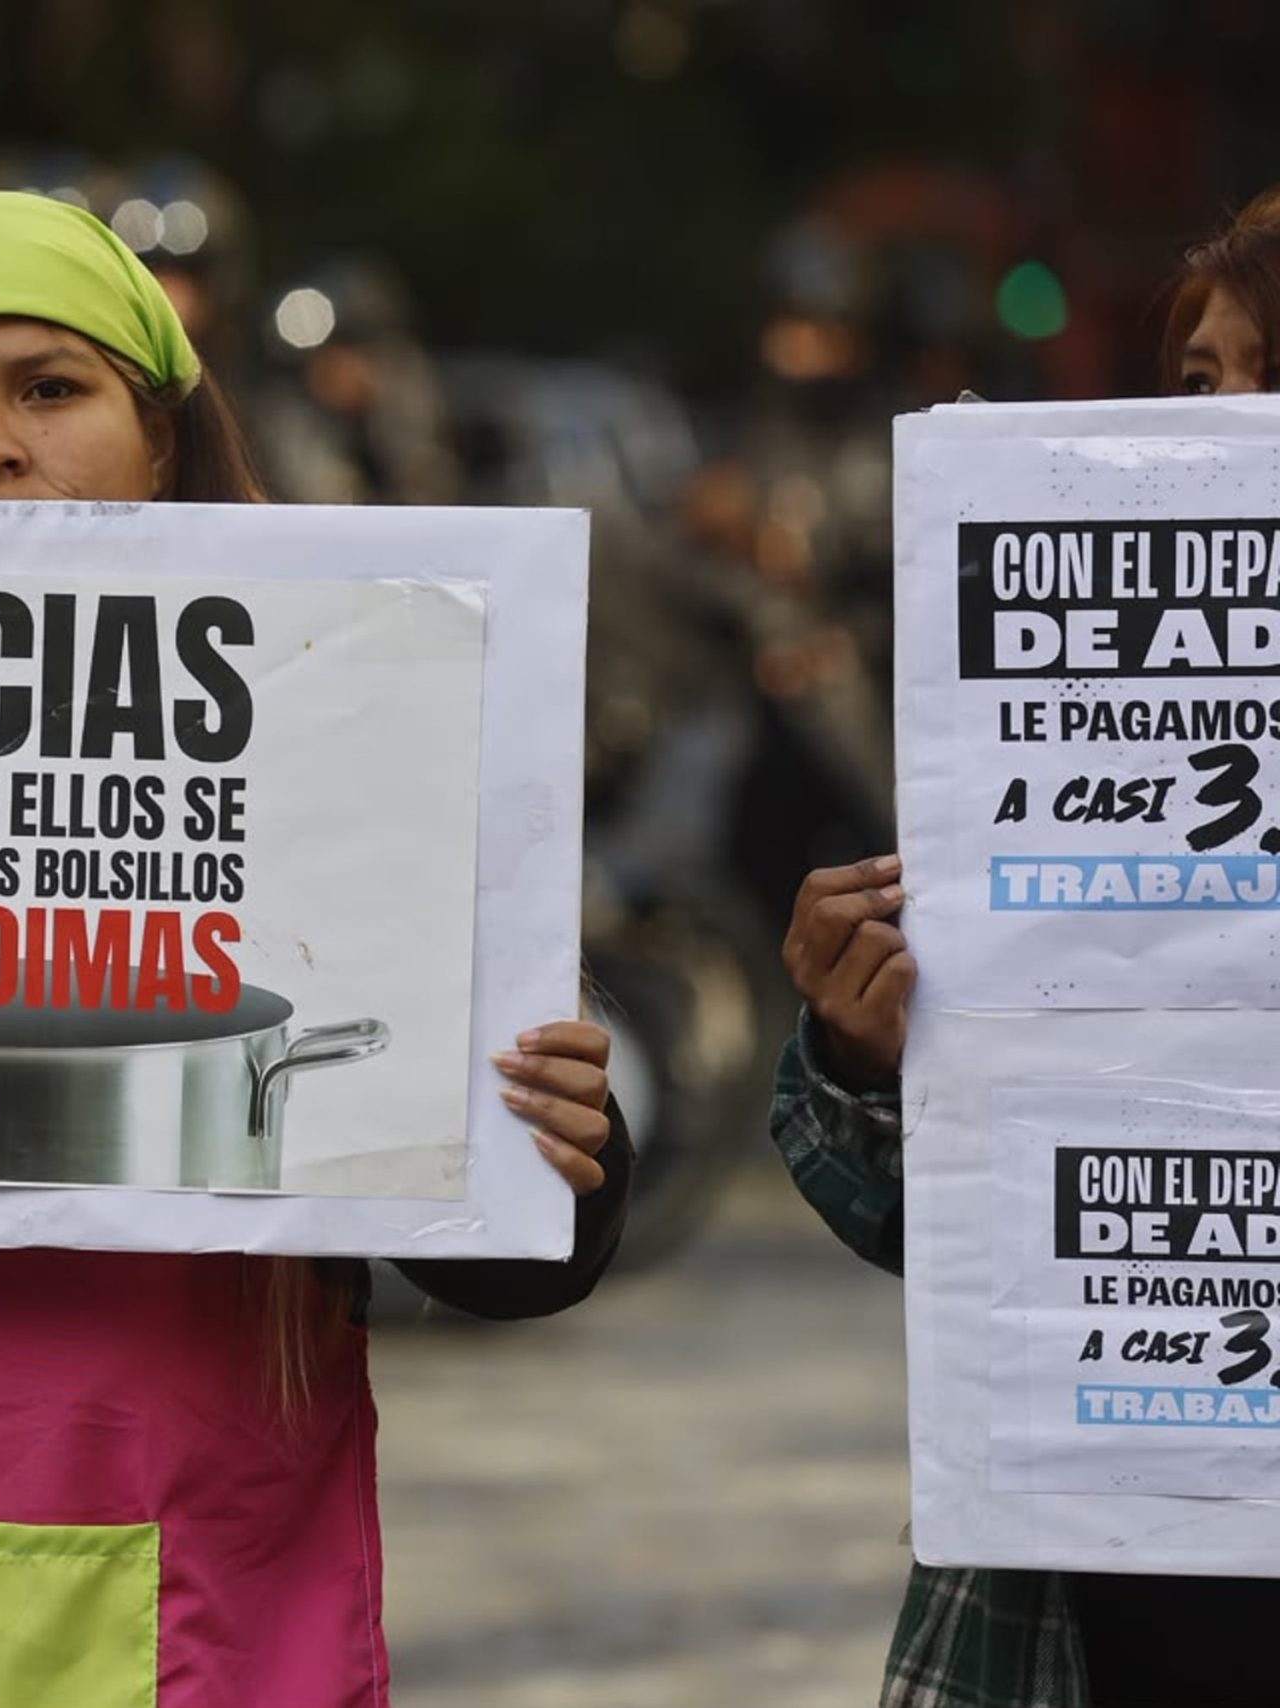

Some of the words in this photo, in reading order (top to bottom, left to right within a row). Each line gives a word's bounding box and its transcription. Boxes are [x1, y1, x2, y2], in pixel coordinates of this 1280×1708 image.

[992, 532, 1093, 601] CON
[1111, 531, 1158, 598] EL
[993, 609, 1119, 669] DE
[1142, 608, 1280, 668] AD
[1000, 701, 1047, 741] LE
[10, 772, 165, 841] ELLOS
[183, 776, 247, 842] SE
[994, 777, 1027, 824] A
[1052, 775, 1176, 824] CASI
[35, 849, 244, 903] BOLSILLOS
[999, 863, 1280, 903] TRABAJ
[1079, 1155, 1152, 1204] CON
[1164, 1157, 1198, 1205] EL
[1079, 1211, 1170, 1255] DE
[1187, 1213, 1280, 1256] AD
[1083, 1276, 1119, 1305] LE
[1127, 1277, 1280, 1308] PAGAMO
[1078, 1329, 1103, 1362] A
[1120, 1329, 1211, 1364] CASI
[1083, 1390, 1280, 1423] TRABAJ
